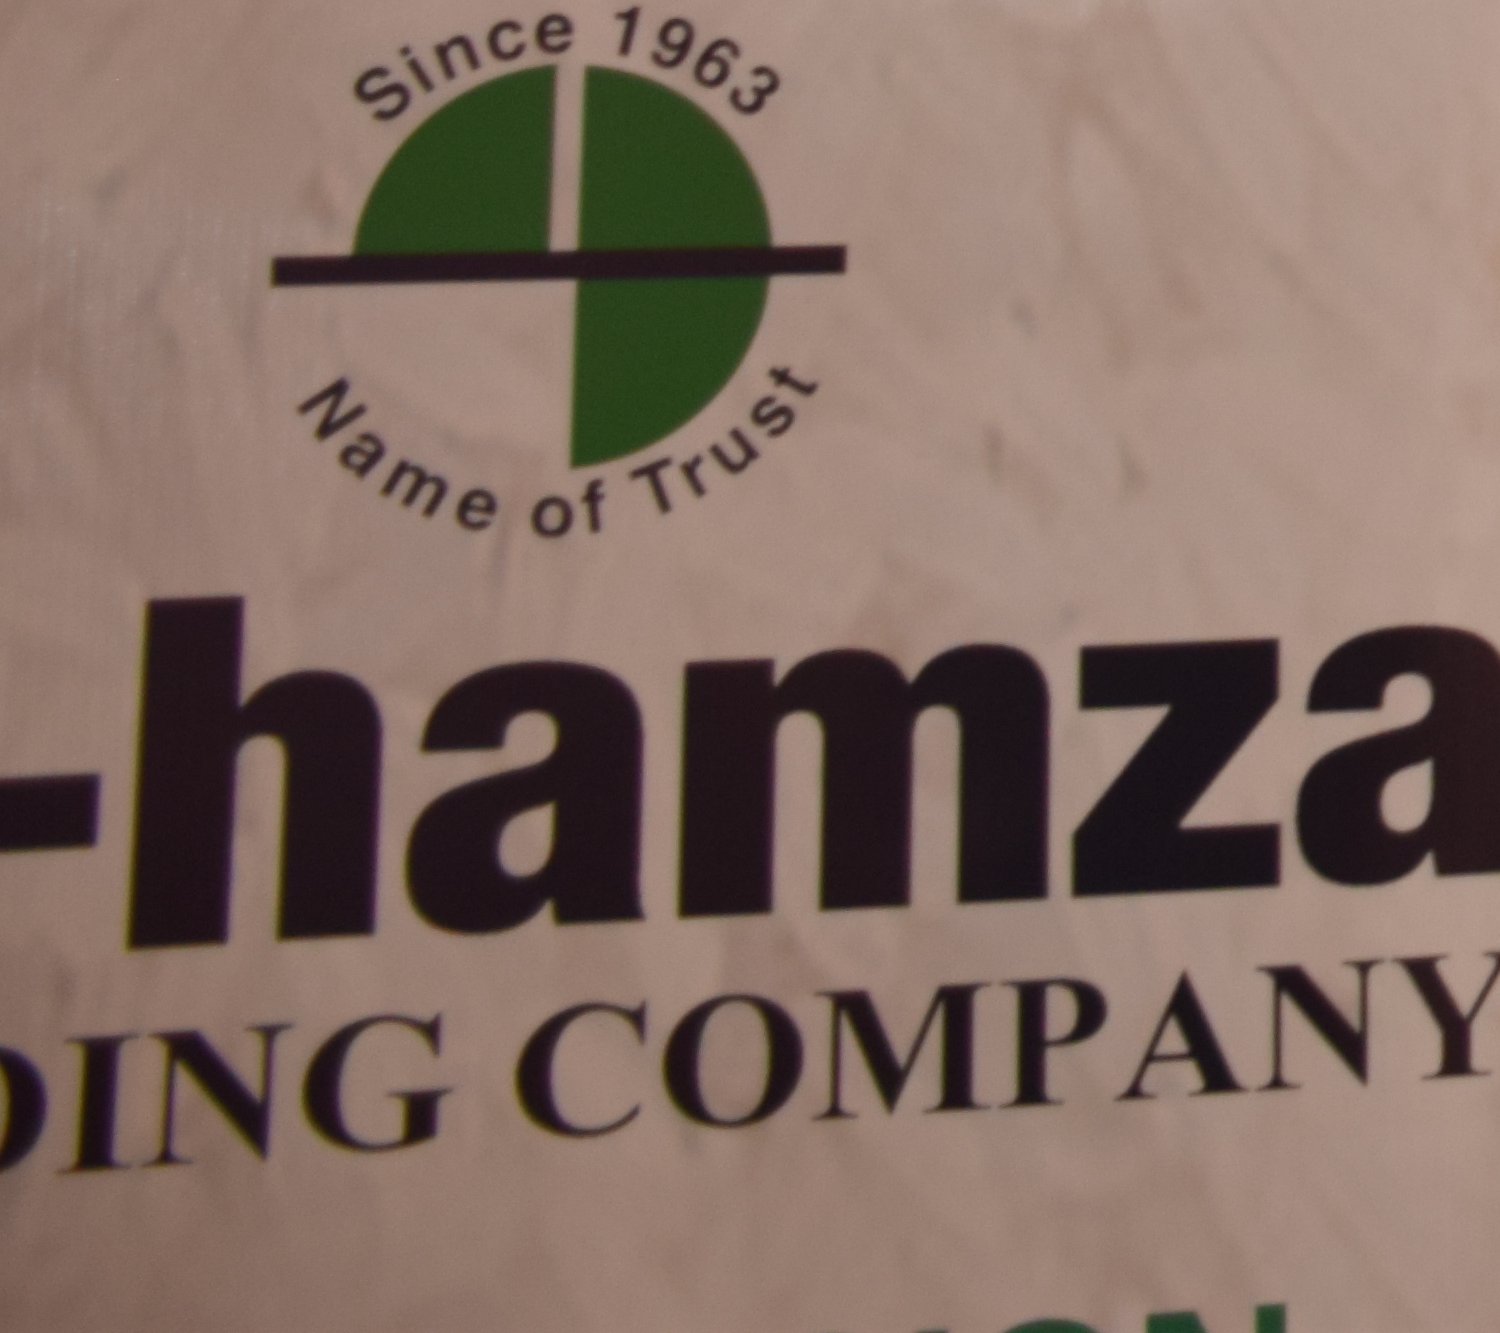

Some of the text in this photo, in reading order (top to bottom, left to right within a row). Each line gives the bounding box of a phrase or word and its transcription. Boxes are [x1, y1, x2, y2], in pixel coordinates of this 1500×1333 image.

[350, 4, 783, 124] Since 1963
[297, 360, 821, 541] Name of Trust
